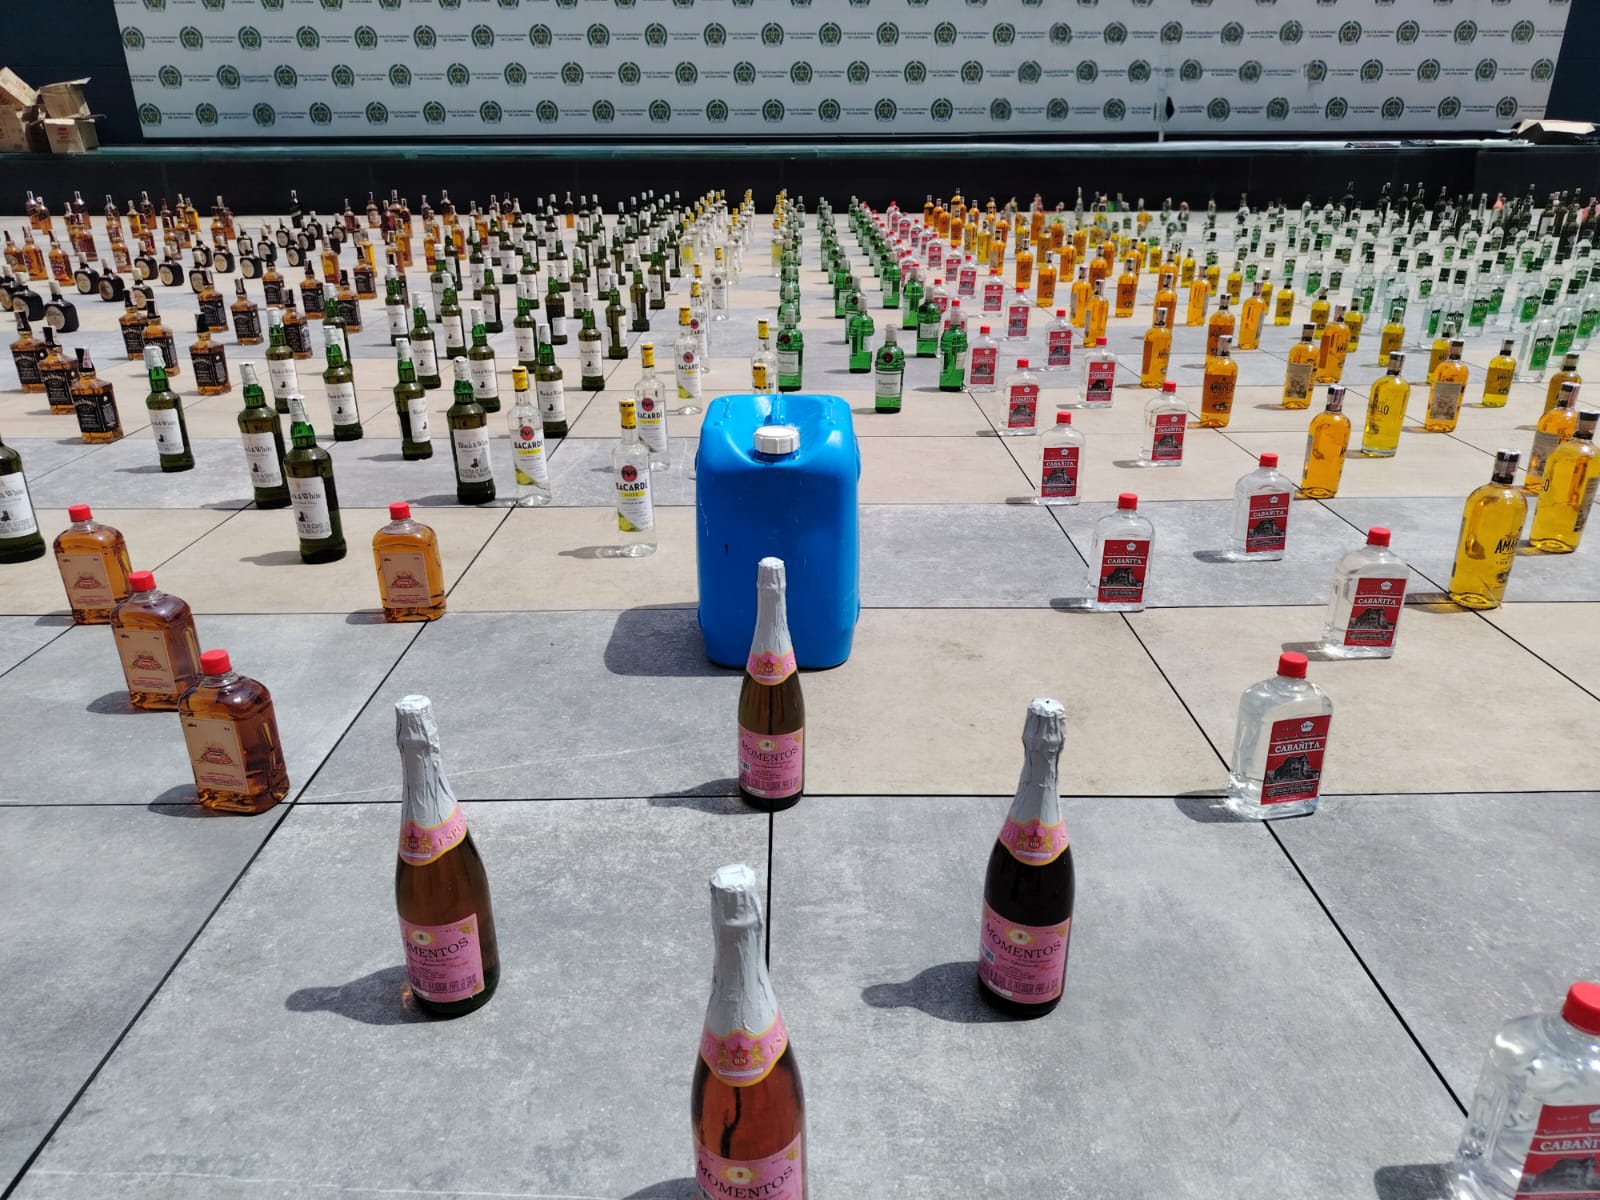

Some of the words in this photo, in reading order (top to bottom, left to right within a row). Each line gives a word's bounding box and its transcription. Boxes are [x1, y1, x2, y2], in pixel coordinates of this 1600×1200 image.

[1358, 596, 1396, 605] CABAÑITA
[742, 739, 799, 762] MOMENTOS
[1275, 741, 1320, 753] CABAÑITA
[406, 937, 469, 958] MENTOS
[985, 923, 1061, 958] MOMENTOS
[698, 1160, 792, 1199] MOMENTOS
